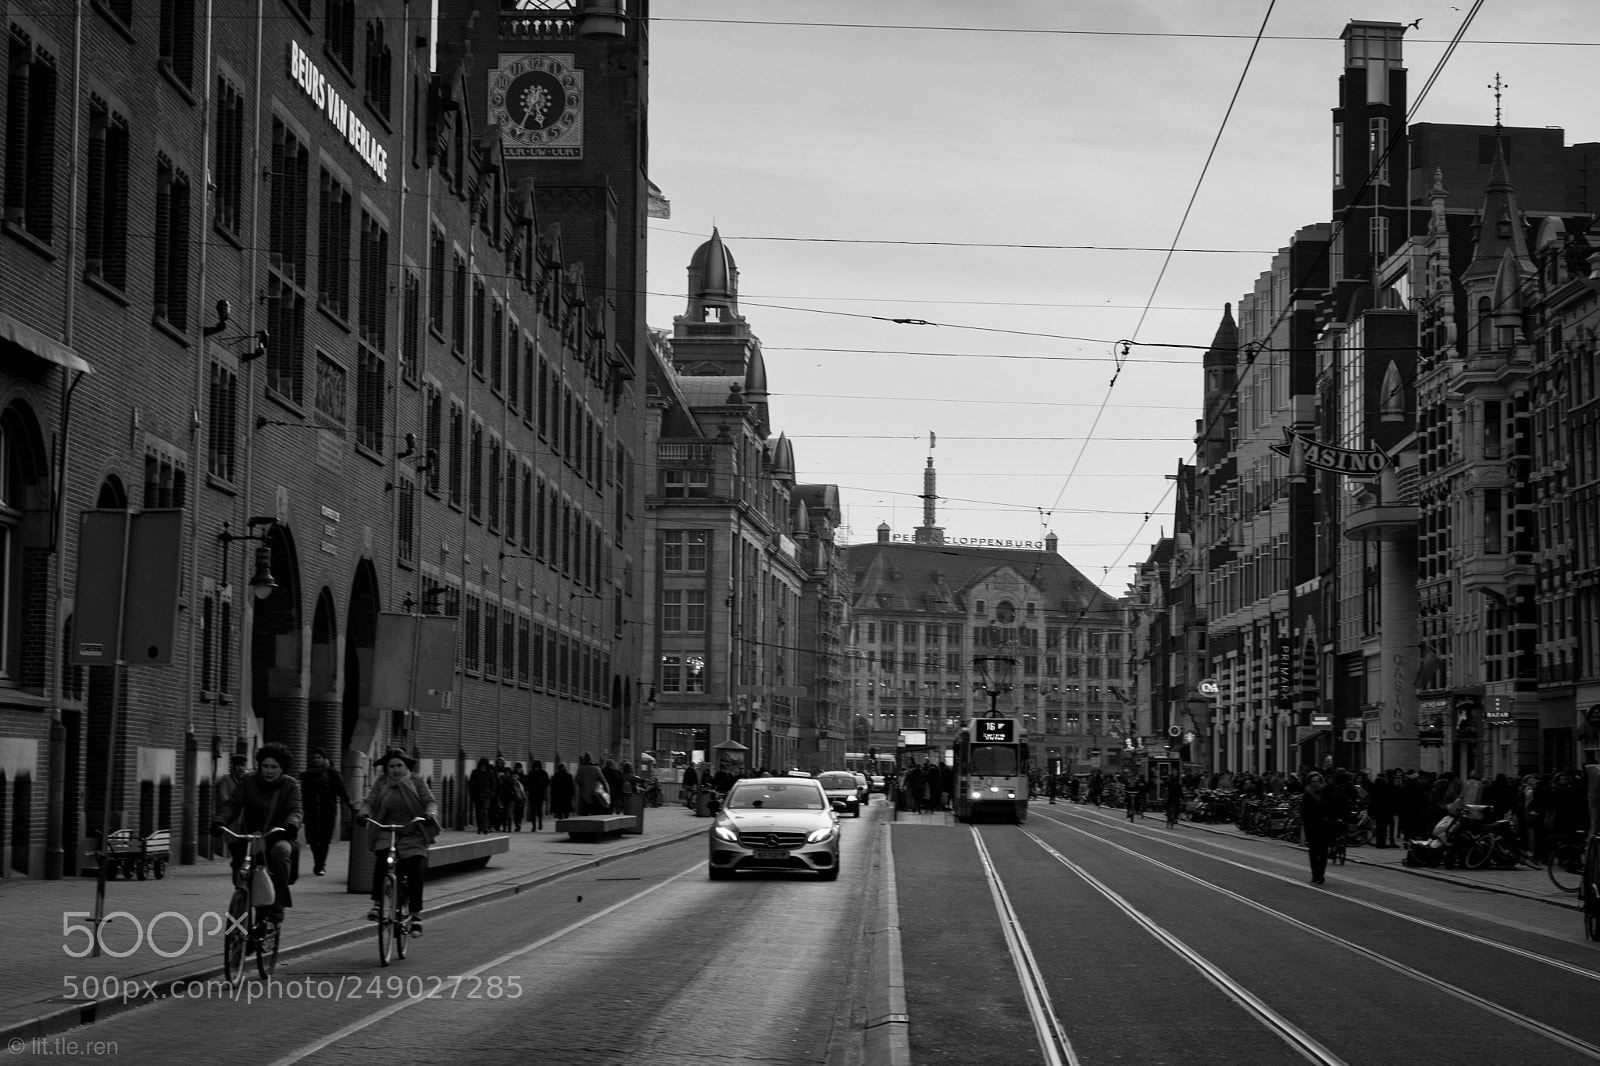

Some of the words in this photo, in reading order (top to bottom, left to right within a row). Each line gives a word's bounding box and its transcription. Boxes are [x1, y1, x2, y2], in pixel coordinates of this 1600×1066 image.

[565, 76, 574, 87] 2
[493, 95, 503, 106] 9
[569, 95, 578, 107] 3
[291, 39, 325, 110] BEURS
[327, 83, 347, 137] VAN
[349, 110, 388, 183] BERLAGE
[530, 132, 540, 143] 6
[549, 127, 559, 138] 5
[1300, 442, 1385, 471] ASINO
[943, 536, 1044, 550] CLOPPENBURG
[1280, 645, 1290, 701] PRIMARK
[1393, 653, 1403, 732] CASINO
